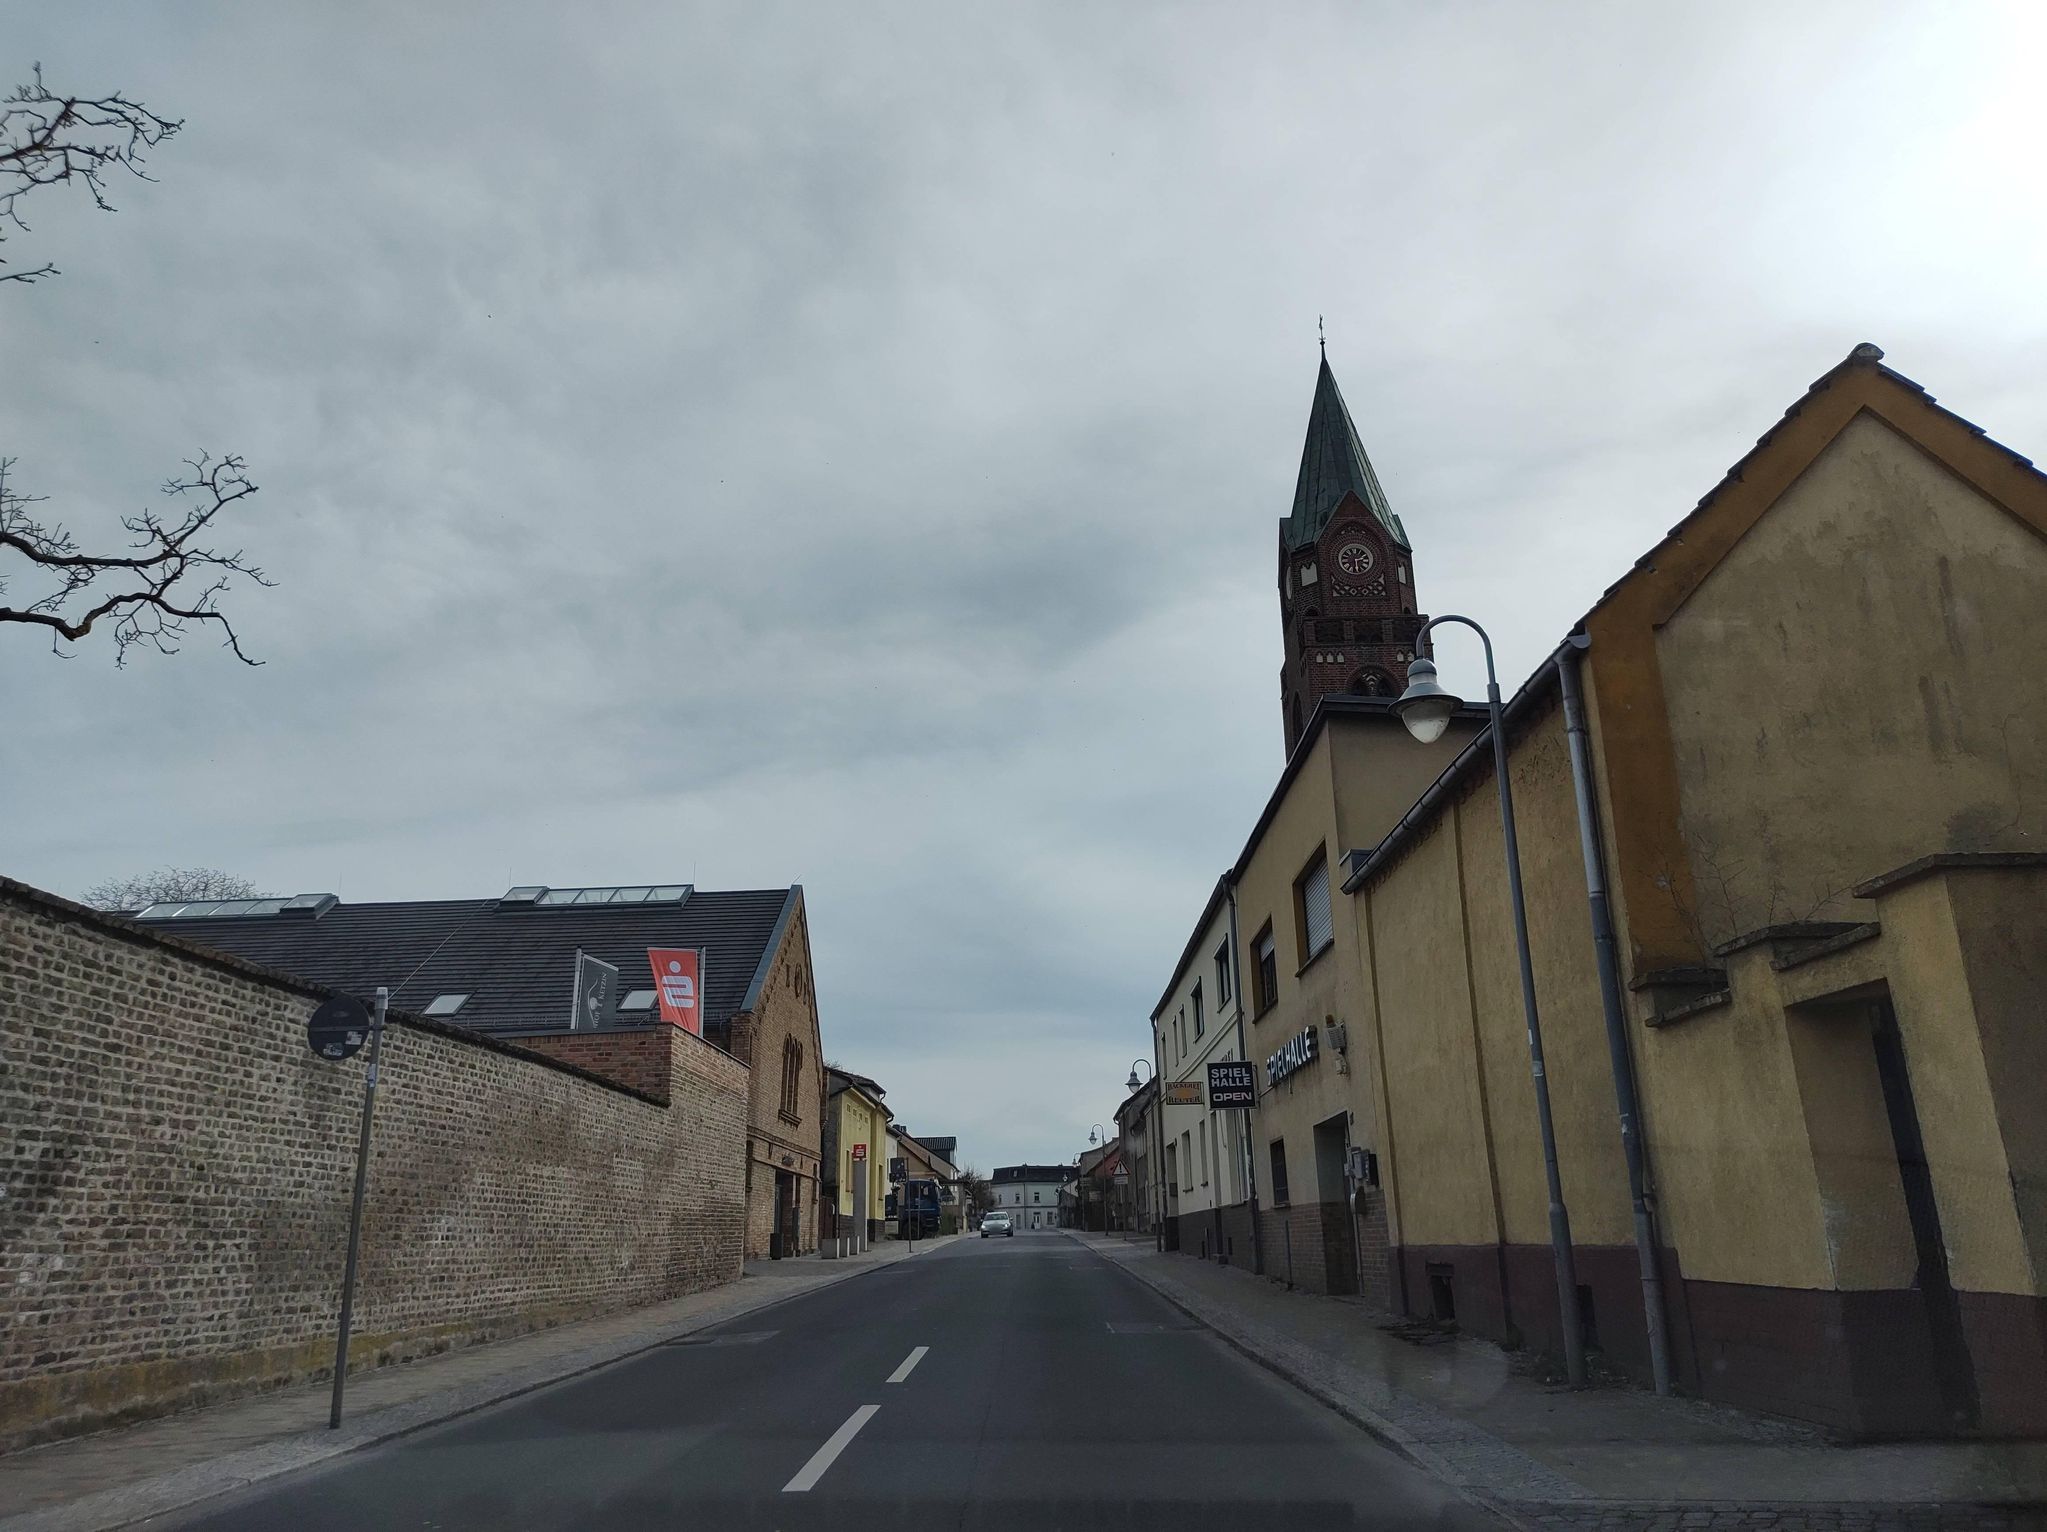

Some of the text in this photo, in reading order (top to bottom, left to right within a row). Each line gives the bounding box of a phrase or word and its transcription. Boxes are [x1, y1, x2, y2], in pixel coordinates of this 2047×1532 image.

[598, 972, 607, 1000] KETZIN
[1266, 1026, 1312, 1086] SPIELHALLE
[1211, 1068, 1250, 1078] SPIEL
[1211, 1077, 1251, 1087] HALLE
[1213, 1092, 1252, 1102] OPEN
